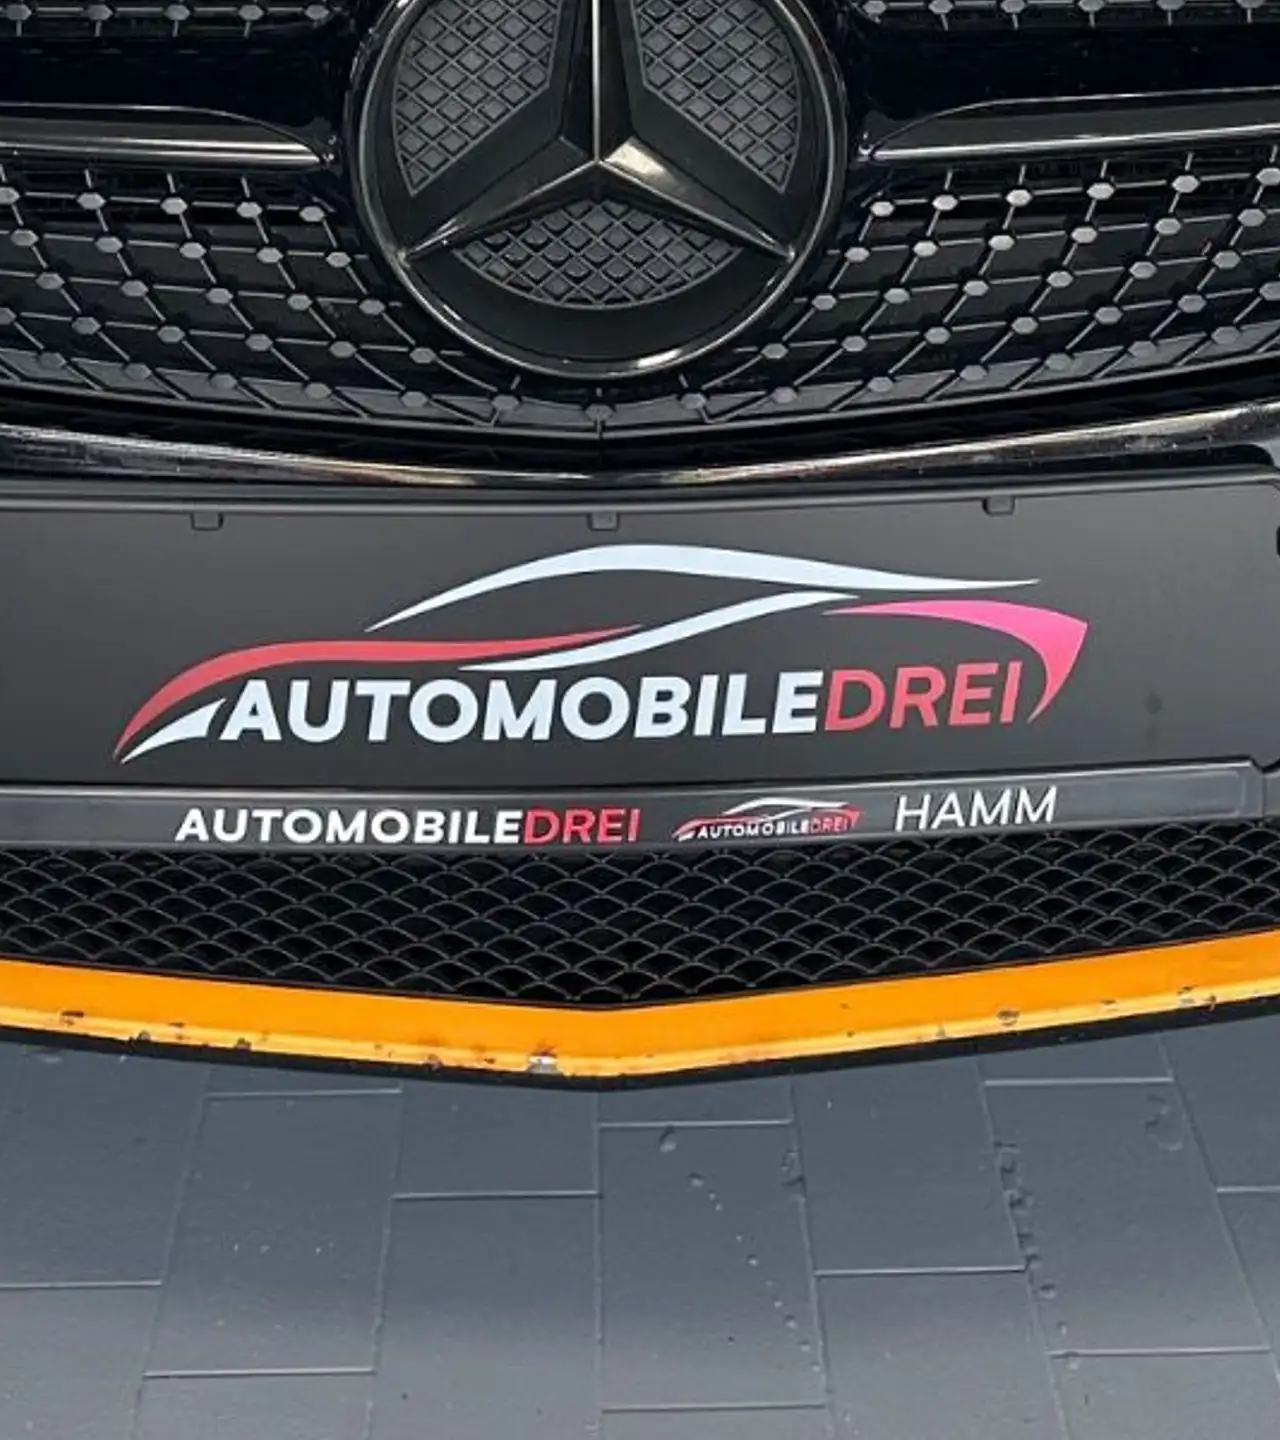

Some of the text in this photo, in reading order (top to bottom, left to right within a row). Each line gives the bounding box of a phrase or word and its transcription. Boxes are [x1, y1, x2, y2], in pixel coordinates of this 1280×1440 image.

[220, 661, 1024, 745] AUTOMOBILEDREI
[175, 808, 641, 845] AUTOMOBILEDREI
[895, 786, 1057, 832] HAMM
